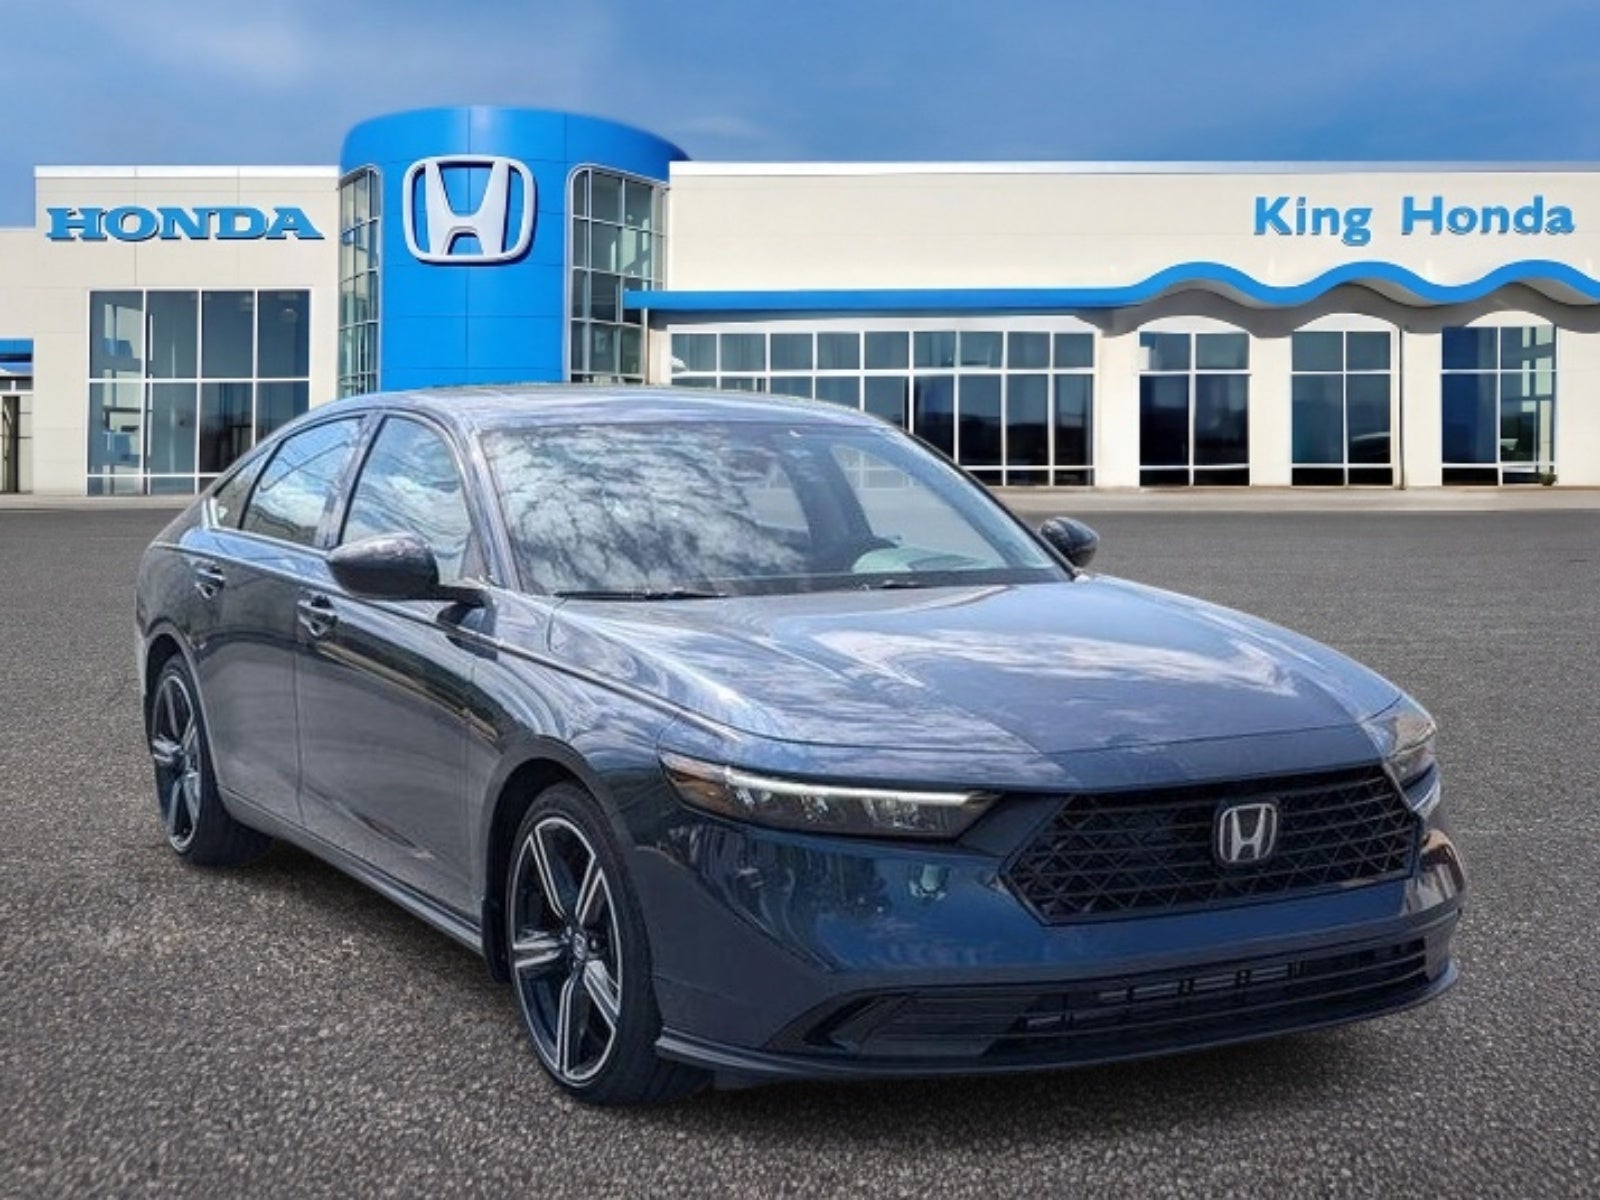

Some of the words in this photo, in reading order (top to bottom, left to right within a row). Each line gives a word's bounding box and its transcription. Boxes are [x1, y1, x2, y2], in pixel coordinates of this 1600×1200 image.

[46, 207, 325, 242] HONDA
[1254, 196, 1373, 246] King
[1401, 195, 1575, 236] Honda
